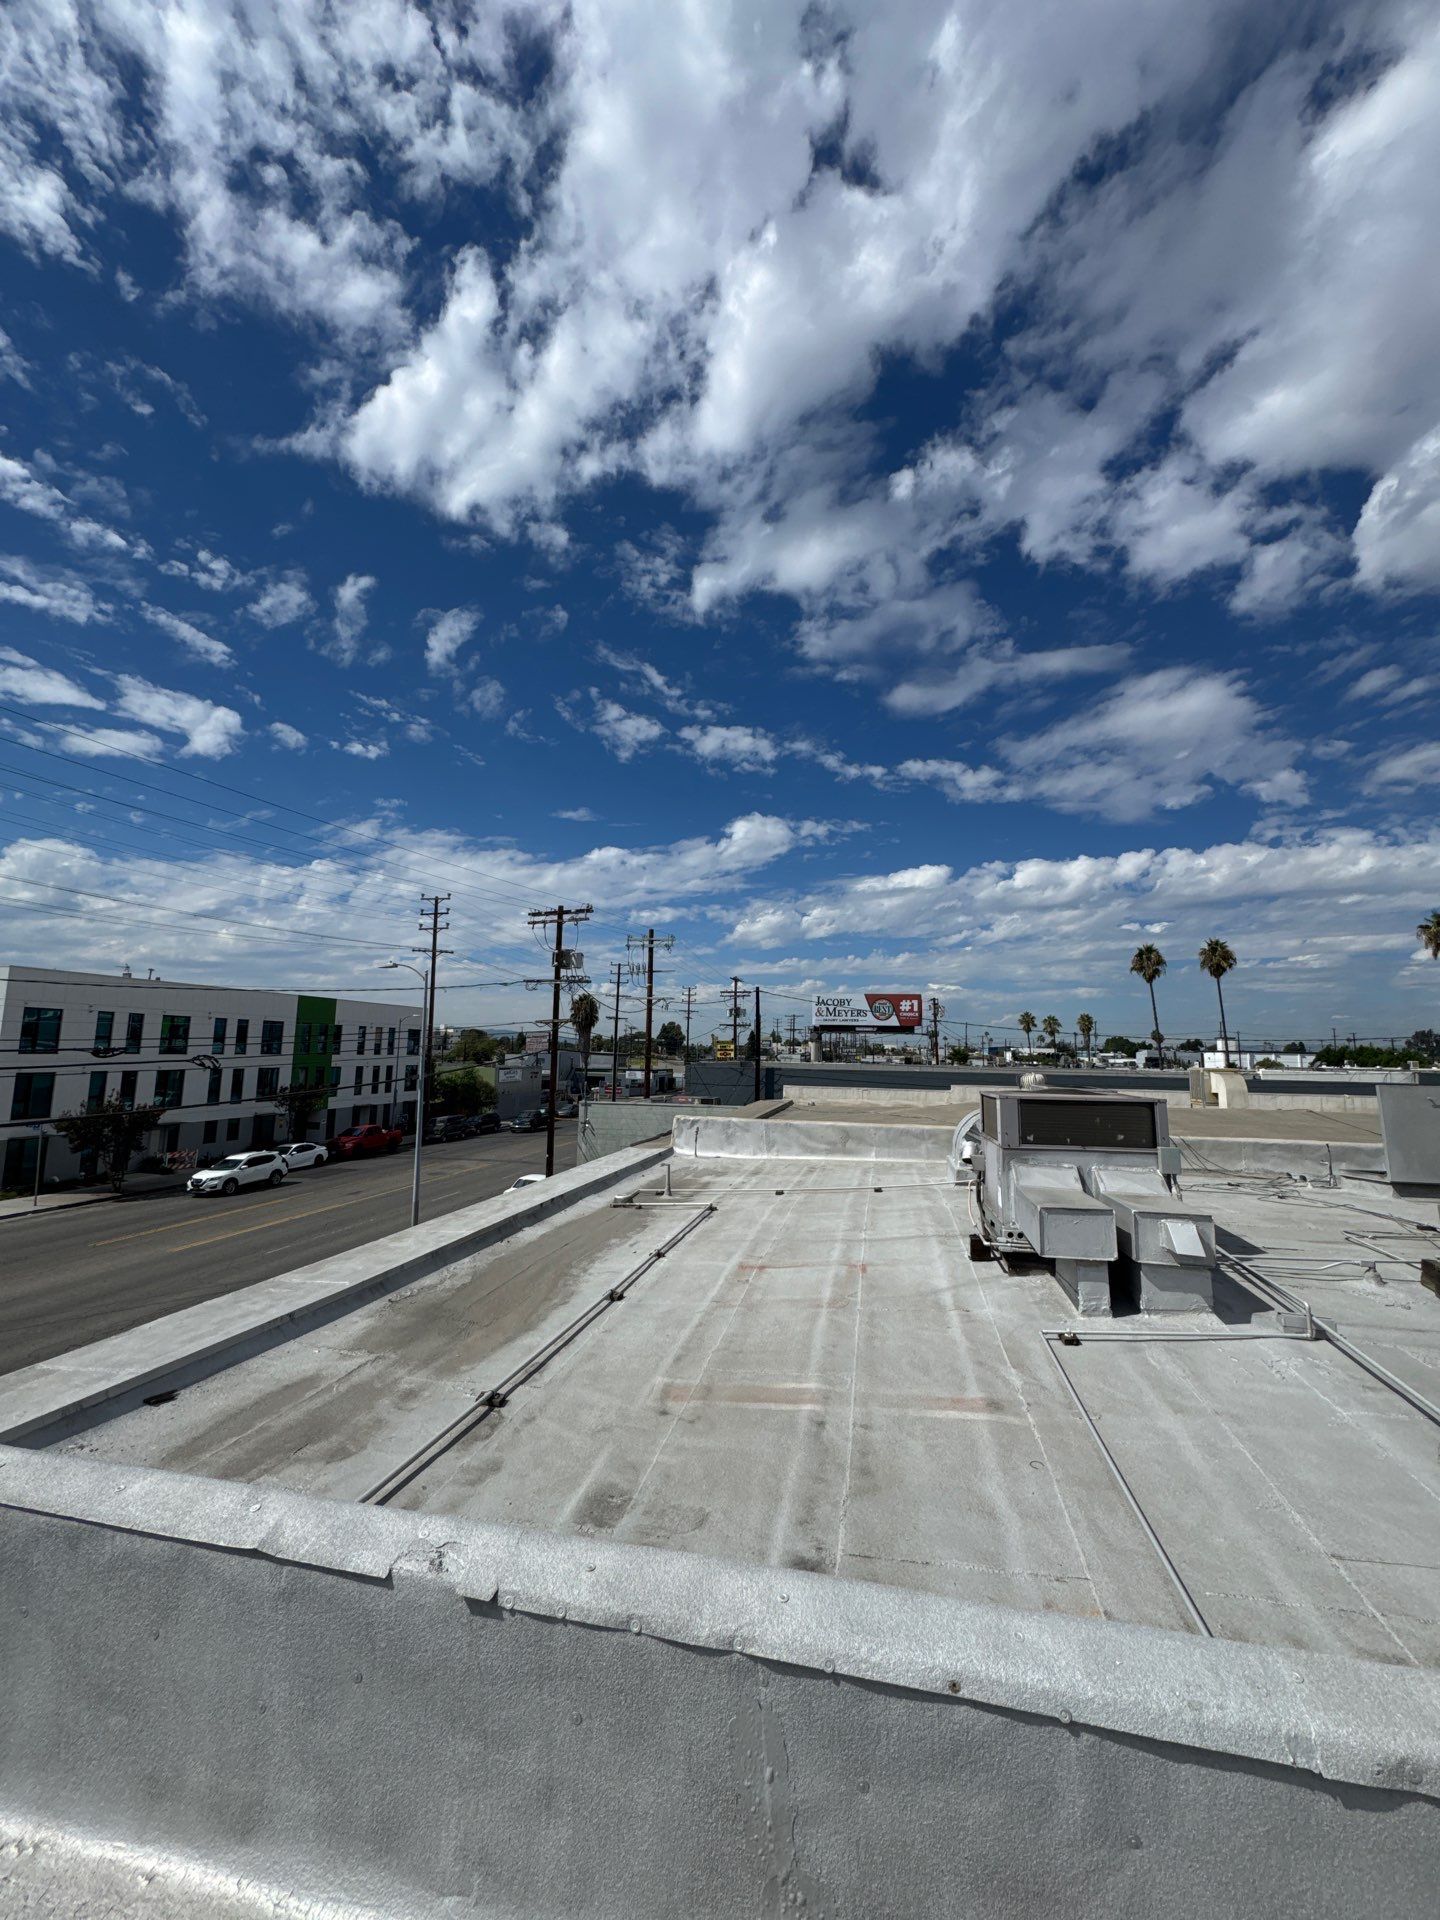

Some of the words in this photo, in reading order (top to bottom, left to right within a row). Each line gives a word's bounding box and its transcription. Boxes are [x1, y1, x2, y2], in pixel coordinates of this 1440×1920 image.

[815, 995, 852, 1006] JACOBY
[900, 999, 918, 1011] #1
[874, 1005, 892, 1013] BEST
